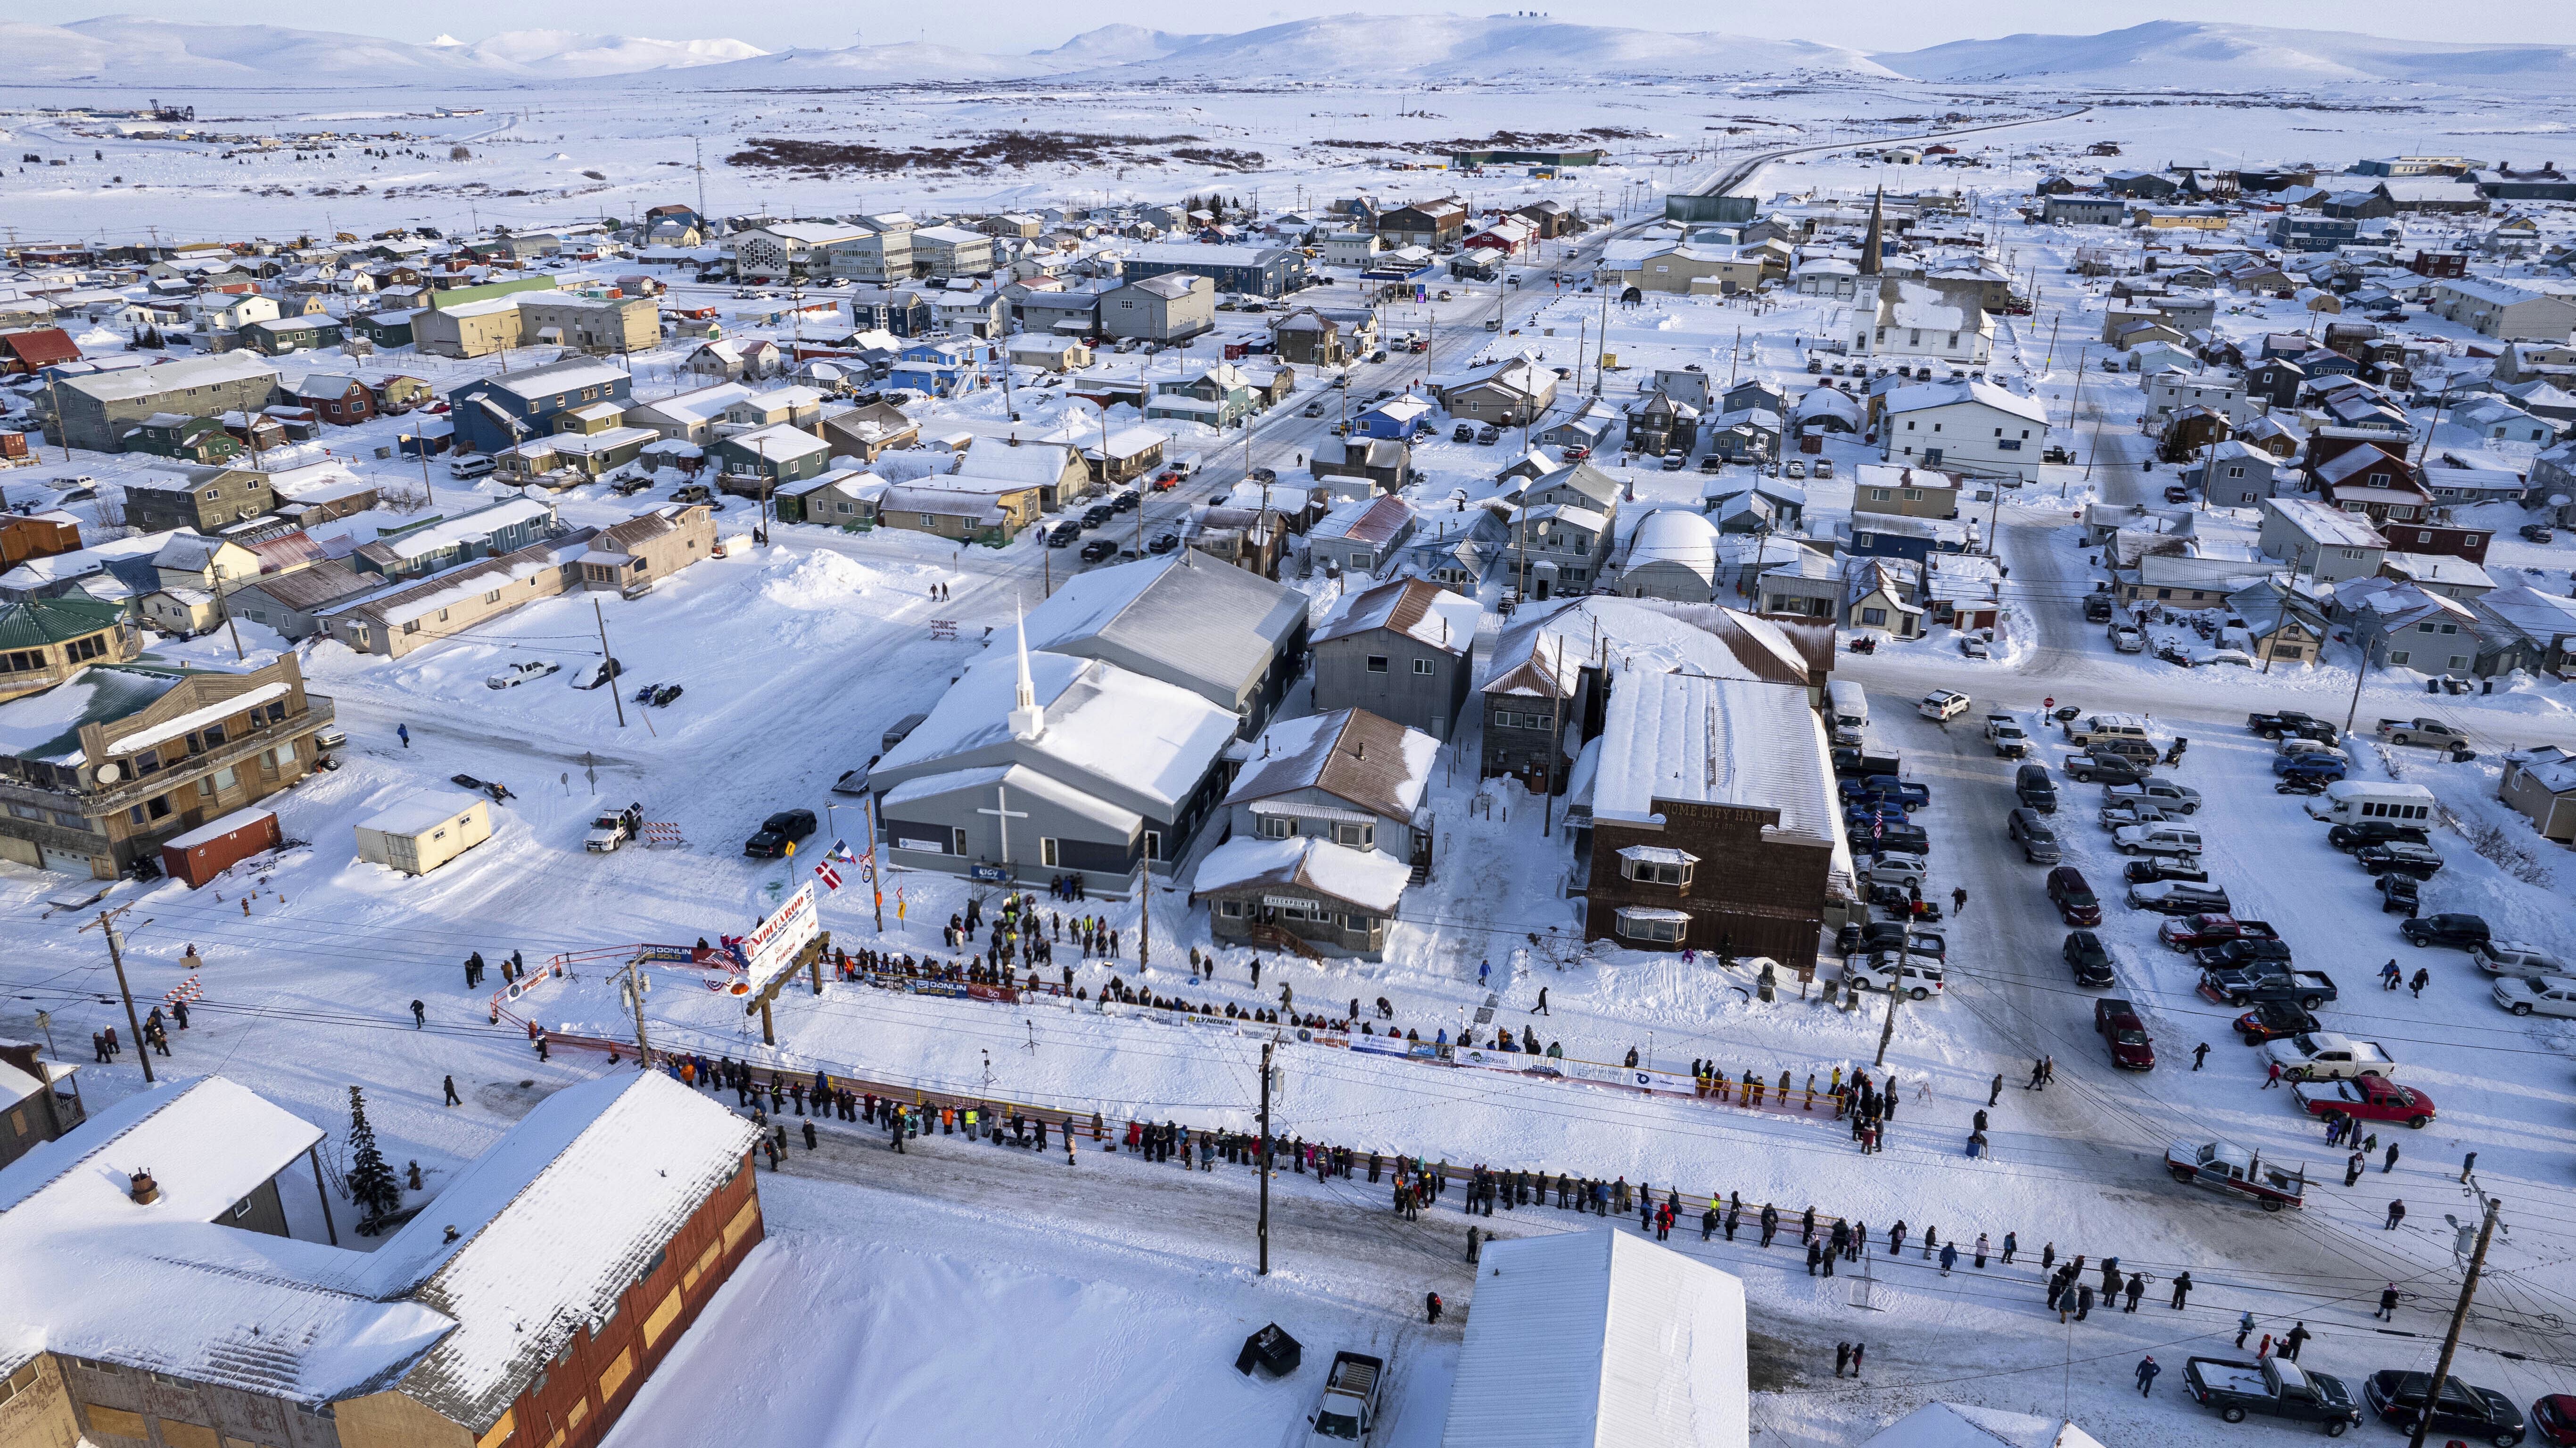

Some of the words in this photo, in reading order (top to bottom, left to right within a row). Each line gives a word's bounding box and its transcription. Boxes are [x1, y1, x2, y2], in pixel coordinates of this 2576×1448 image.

[1662, 803, 1697, 817] NOME
[1702, 806, 1731, 820] CITY
[1735, 810, 1770, 823] HALL
[979, 868, 998, 876] KICY
[1267, 897, 1309, 906] CHECKPOINT
[766, 931, 777, 944] SLED
[778, 921, 787, 935] DOG
[789, 910, 799, 923] RACE
[776, 940, 795, 964] FINISH
[930, 982, 967, 991] DONLIN
[1195, 1017, 1232, 1026] LYNDEN
[1461, 1053, 1486, 1061] Alaska
[1533, 1065, 1554, 1073] SIGNS
